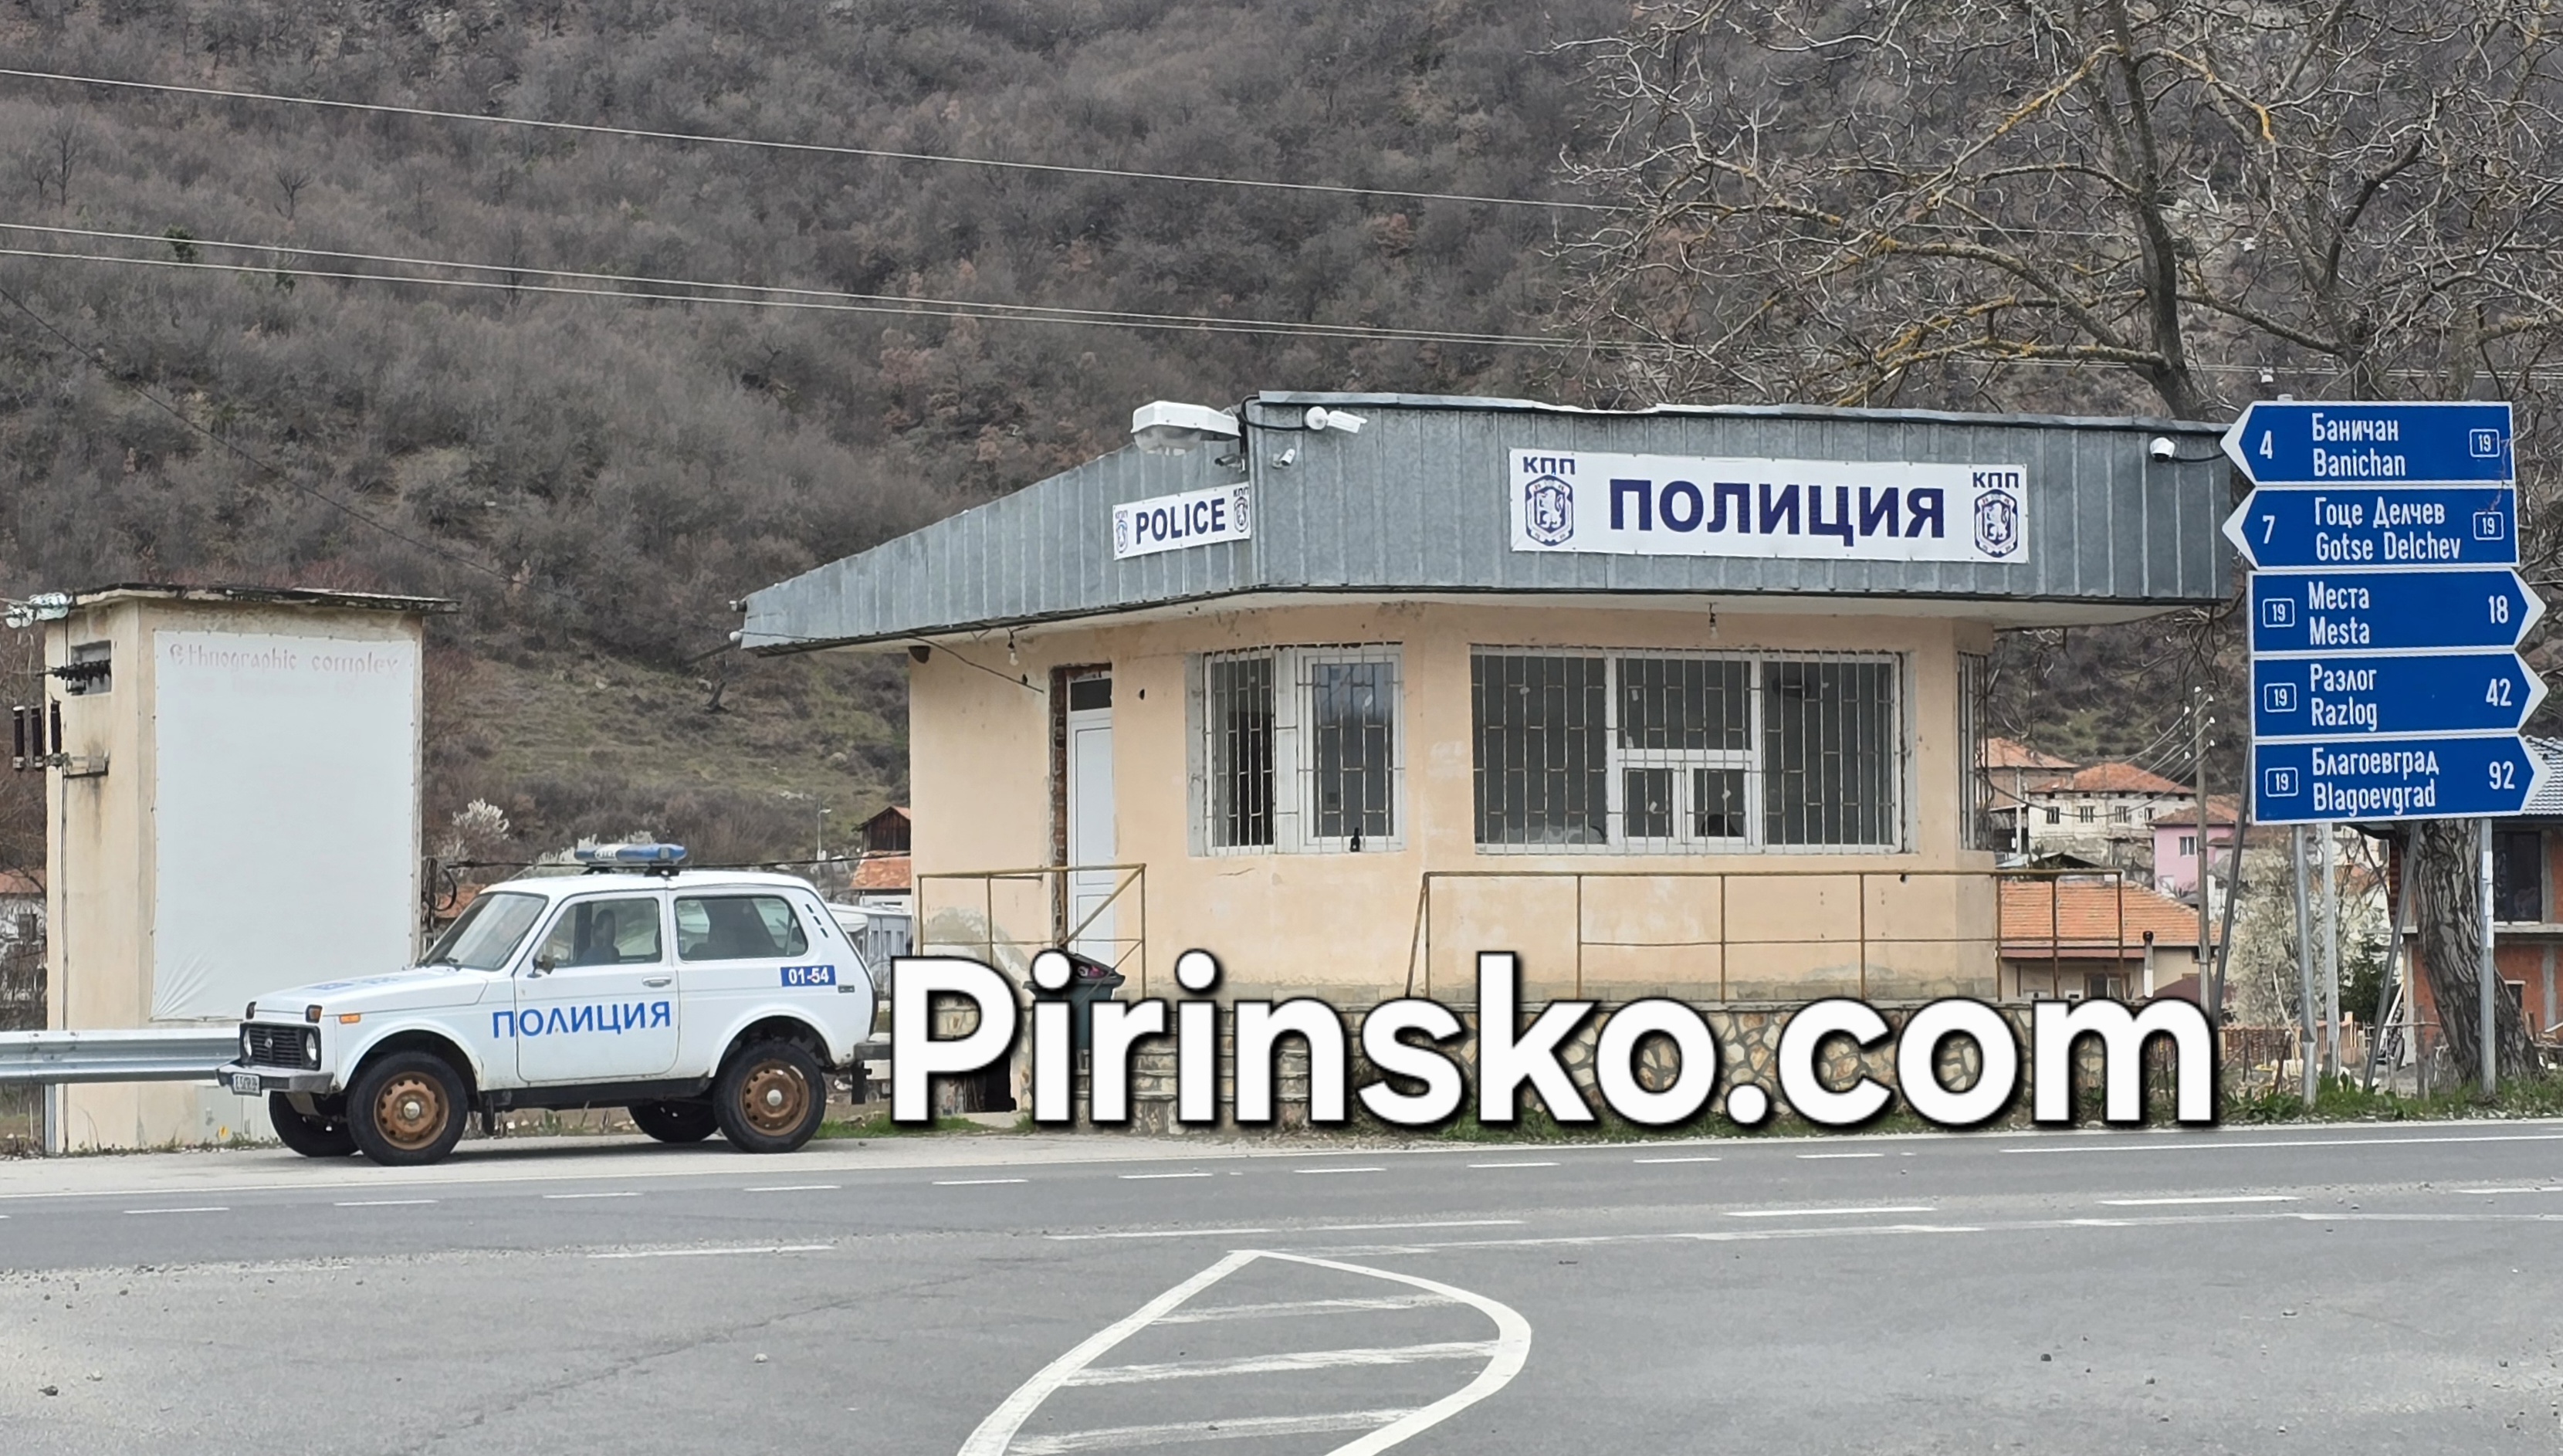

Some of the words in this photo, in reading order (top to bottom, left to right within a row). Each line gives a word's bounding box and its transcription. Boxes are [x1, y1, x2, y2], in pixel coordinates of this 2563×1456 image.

[2312, 413, 2399, 442] Баничан
[2260, 430, 2274, 459] 4
[2478, 434, 2491, 452] 19
[1523, 456, 1576, 475] КПП
[2314, 448, 2406, 476] Banichan
[1972, 472, 2019, 489] КПП
[1136, 497, 1226, 545] POLICE
[1609, 479, 1945, 547] ПОЛИЦИЯ
[2314, 497, 2363, 529] Гоце
[2373, 496, 2446, 528] Делчев
[2482, 516, 2495, 535] 19
[2262, 515, 2275, 544] 7
[2316, 533, 2374, 561] Gotse
[2384, 531, 2461, 560] Delchev
[2308, 581, 2370, 610] Места
[2488, 595, 2509, 624] 18
[2272, 603, 2286, 622] 19
[2309, 616, 2370, 645] Mesta
[311, 652, 398, 678] complex
[2310, 663, 2377, 692] Разлог
[2274, 688, 2287, 706] 19
[2485, 678, 2512, 706] 42
[2311, 696, 2378, 731] Razlog
[2312, 747, 2439, 780] Благоевград
[2489, 760, 2515, 790] 92
[2275, 773, 2289, 791] 19
[2313, 779, 2436, 817] Blagoevgrad
[788, 967, 829, 984] 01-54
[493, 1001, 671, 1038] ПОЛИЦИЯ
